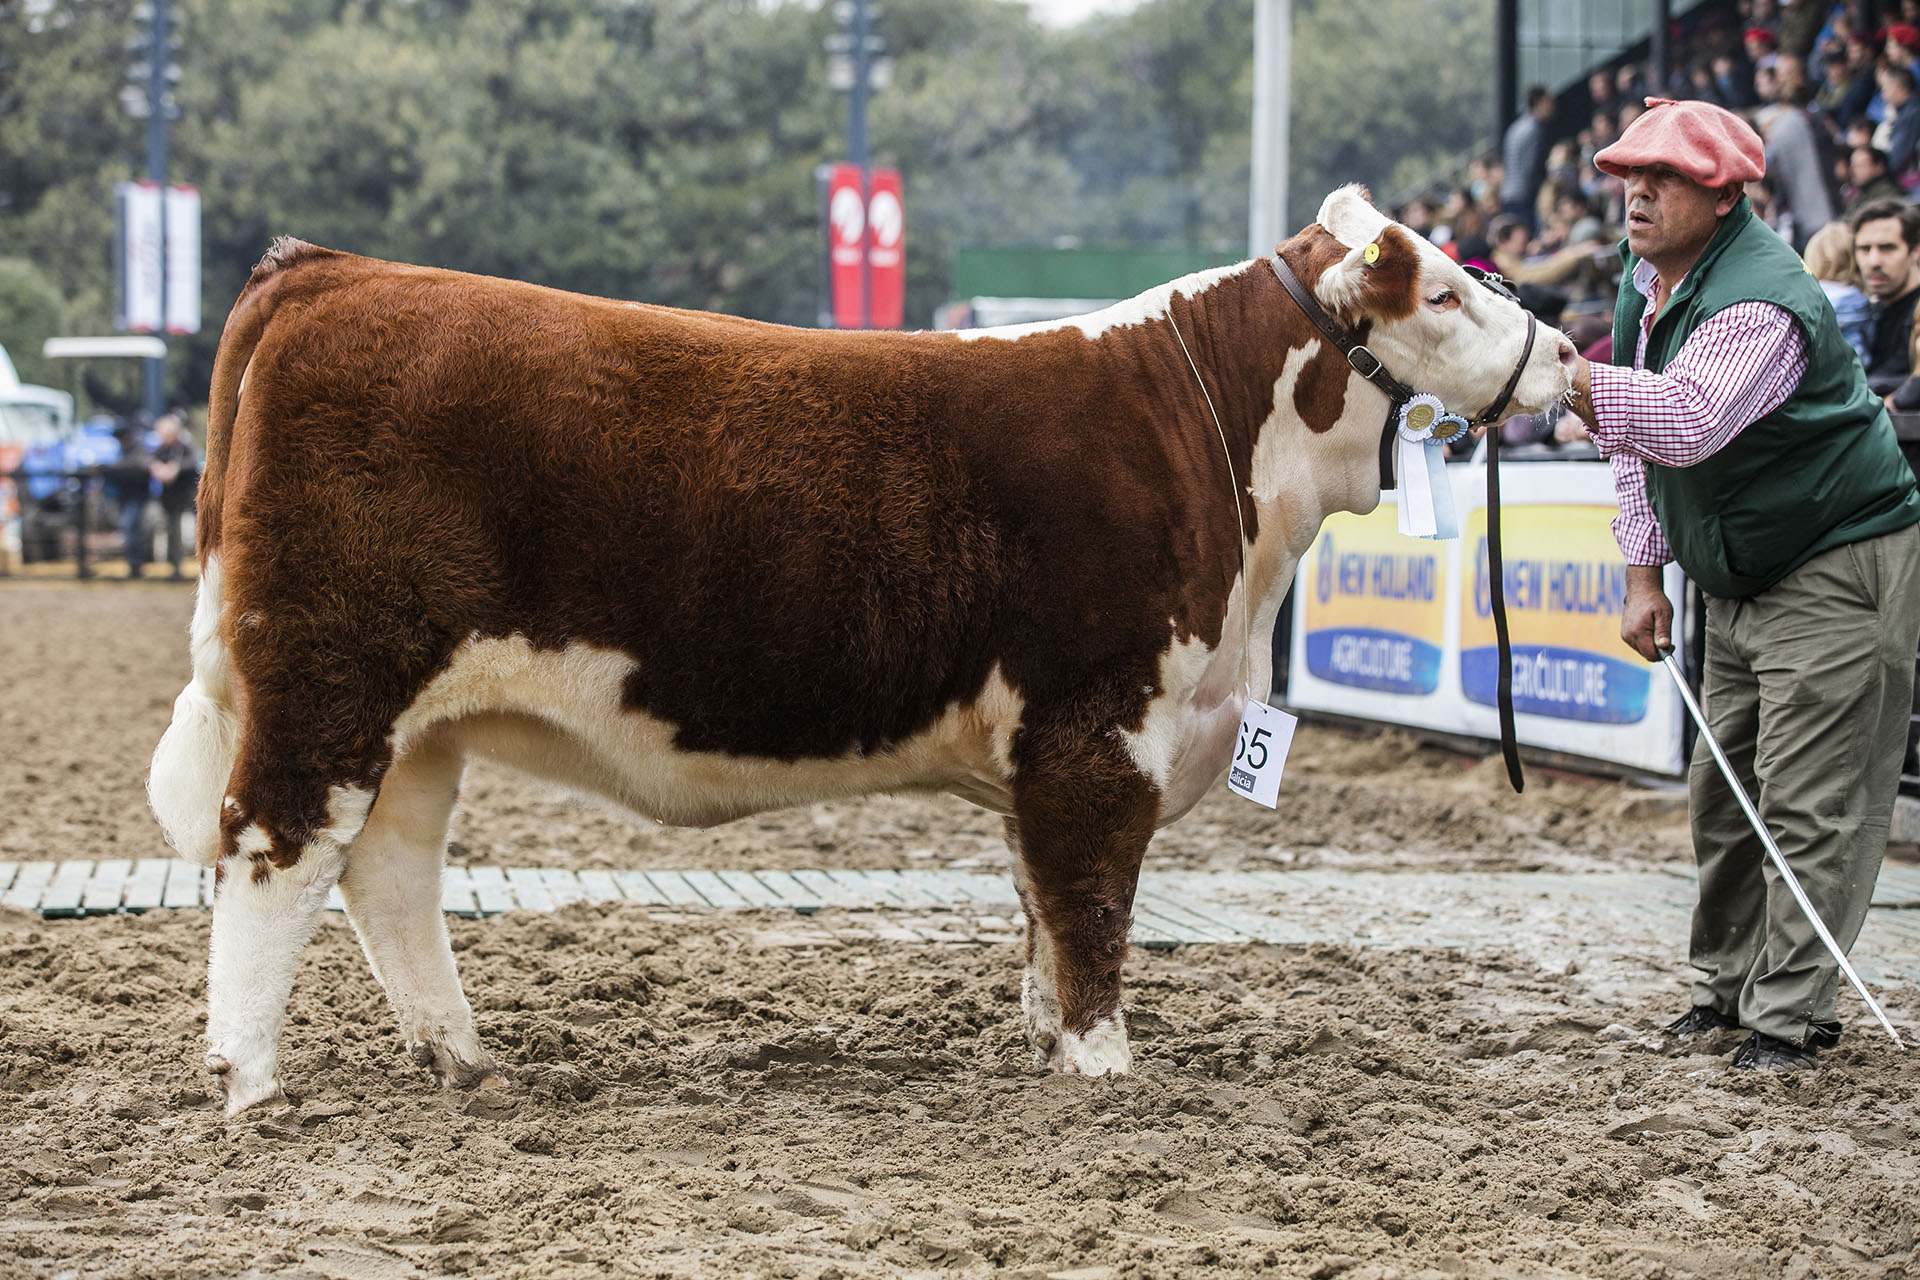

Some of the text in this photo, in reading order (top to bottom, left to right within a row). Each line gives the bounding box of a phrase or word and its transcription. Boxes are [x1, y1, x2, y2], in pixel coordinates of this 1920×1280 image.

[1338, 553, 1435, 602] NEW HOLLAND
[1503, 561, 1626, 615] NEW HOLLAN
[1331, 634, 1412, 682] AGRICULTURE
[1511, 655, 1606, 706] GRICULTURE
